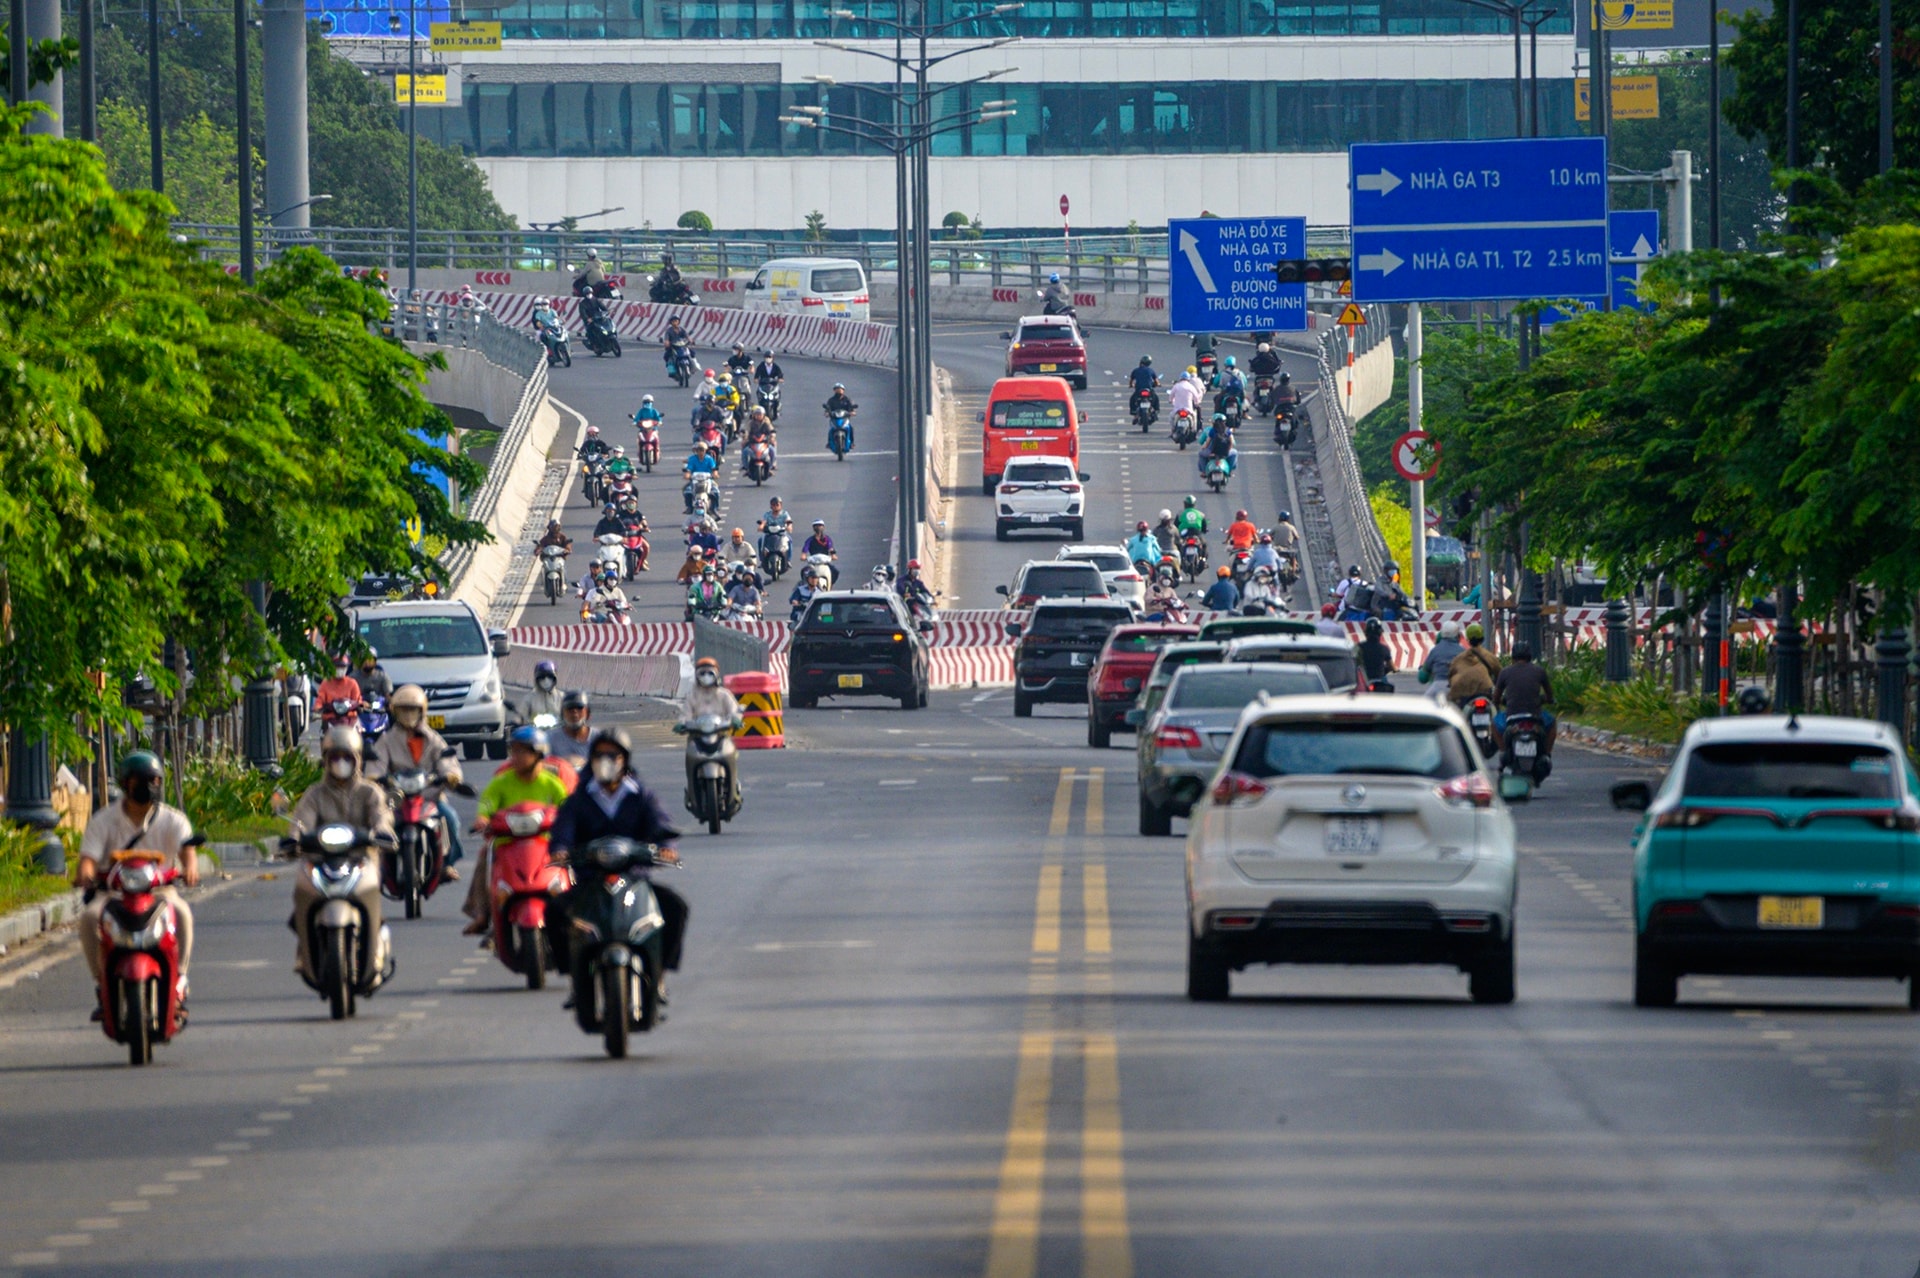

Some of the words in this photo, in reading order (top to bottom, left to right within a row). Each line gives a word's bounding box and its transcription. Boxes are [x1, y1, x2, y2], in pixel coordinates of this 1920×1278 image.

[1411, 168, 1448, 189] NHÀ
[1453, 171, 1477, 189] GA
[1481, 170, 1500, 188] T3
[1550, 168, 1570, 186] 1.0
[1575, 168, 1600, 185] km
[1219, 222, 1246, 239] NHÀ
[1250, 220, 1268, 238] ĐỖ
[1271, 225, 1287, 238] XE
[1220, 240, 1248, 256] NHÀ
[1252, 243, 1270, 256] GA
[1273, 242, 1287, 255] T3
[1234, 260, 1251, 273] 0.6
[1255, 260, 1274, 272] km
[1413, 248, 1450, 270] NHÀ
[1455, 252, 1478, 269] GA
[1513, 250, 1532, 268] T2
[1548, 249, 1571, 267] 2.5
[1576, 249, 1602, 266] km
[1231, 277, 1277, 293] ĐƯỜNG
[1206, 293, 1259, 311] TRƯỜNG
[1262, 296, 1302, 310] CHINH
[1235, 315, 1252, 328] 2.6
[1255, 315, 1274, 327] km
